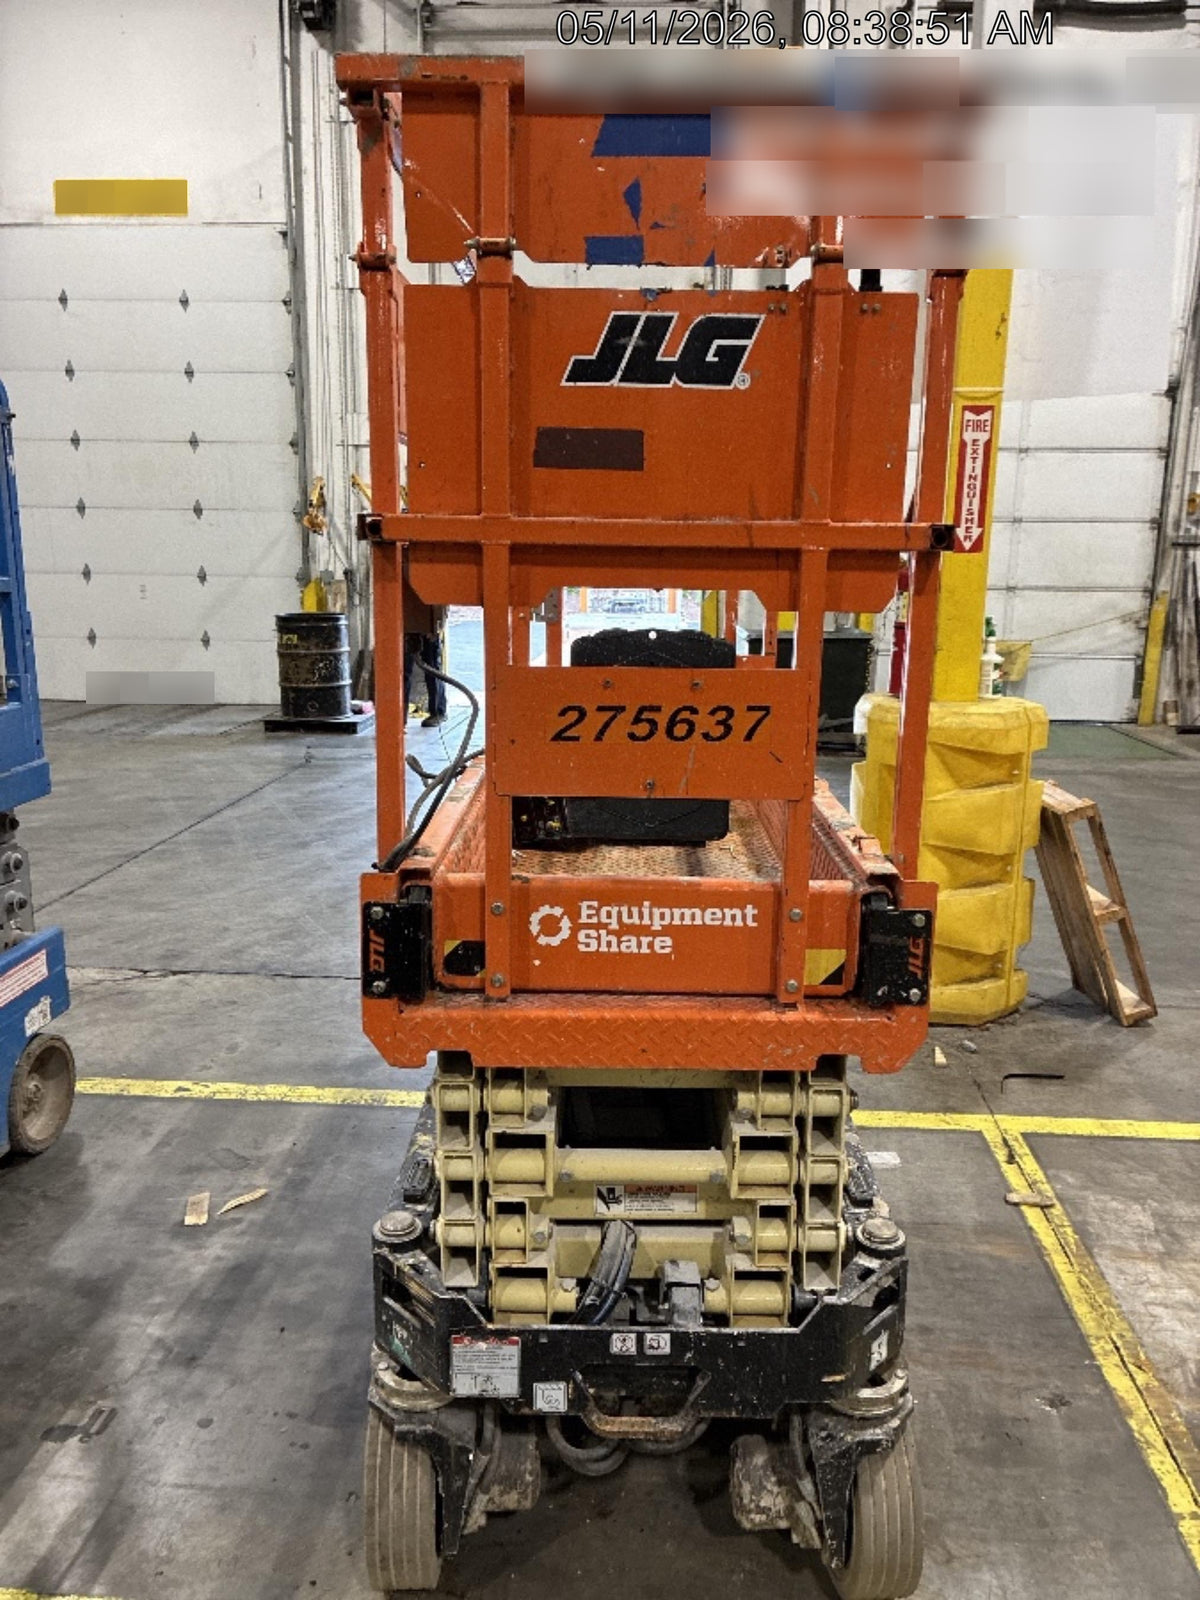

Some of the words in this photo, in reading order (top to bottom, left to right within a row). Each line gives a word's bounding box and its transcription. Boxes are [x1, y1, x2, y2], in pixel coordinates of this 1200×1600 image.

[965, 419, 989, 432] FIRE
[963, 439, 980, 542] EXTINGUISHER
[550, 704, 772, 743] 275637
[578, 900, 758, 930] Equipment
[369, 928, 385, 973] JLG
[577, 929, 673, 954] Share
[908, 936, 924, 980] JLG
